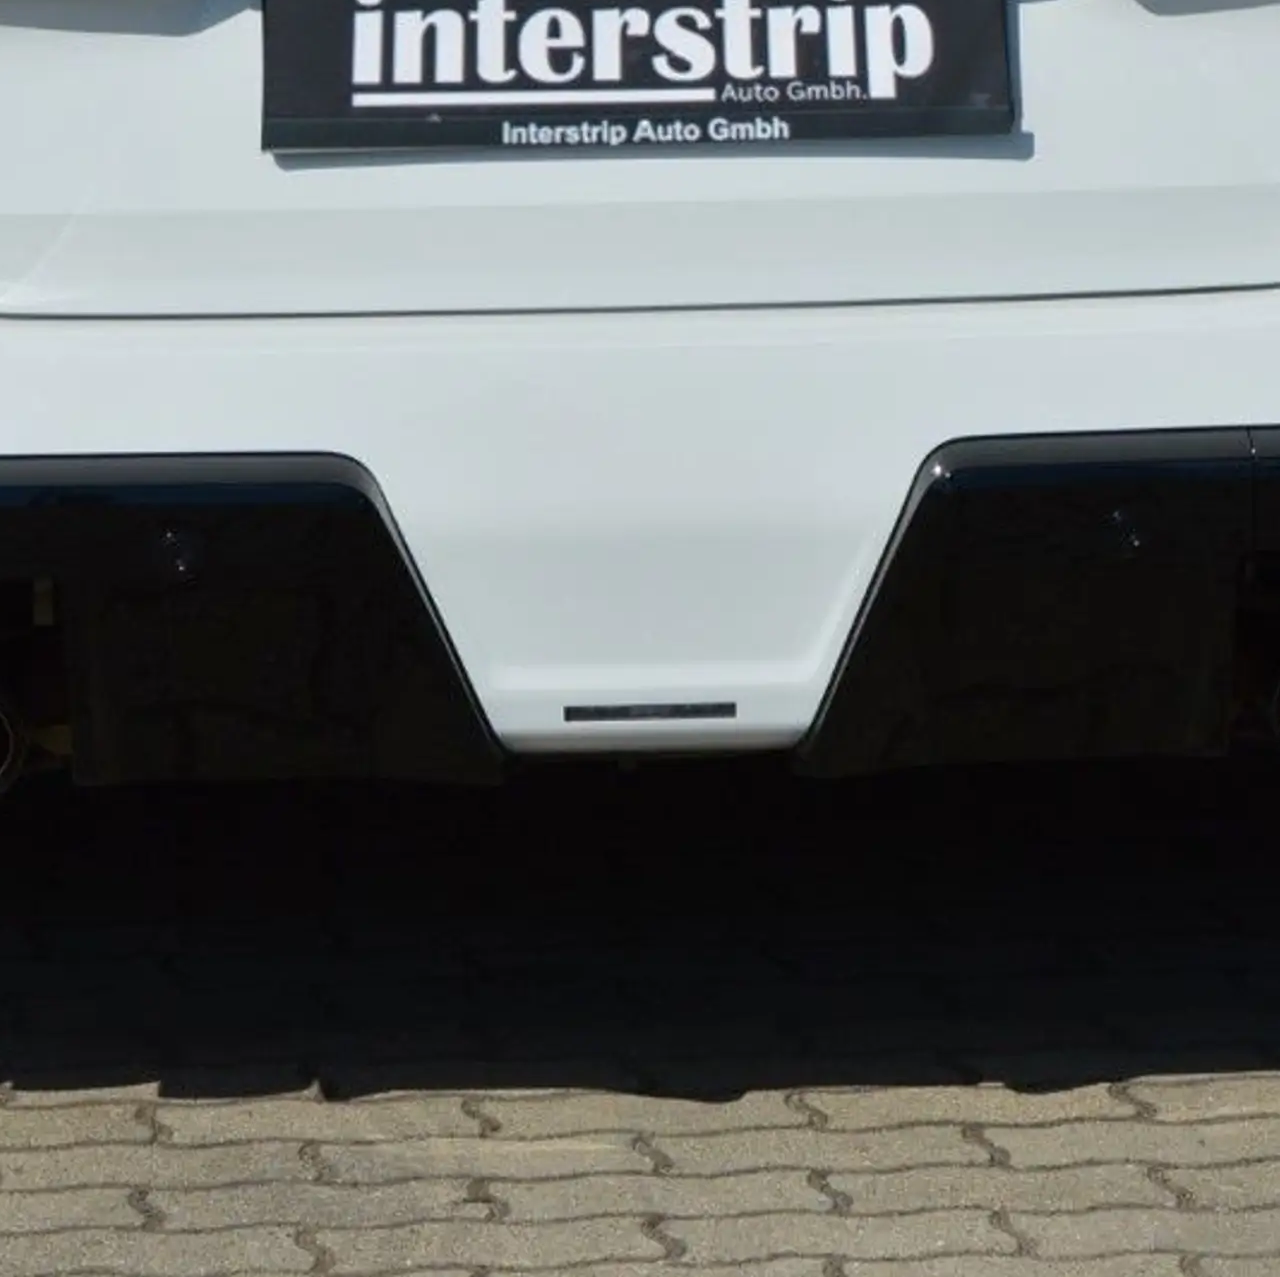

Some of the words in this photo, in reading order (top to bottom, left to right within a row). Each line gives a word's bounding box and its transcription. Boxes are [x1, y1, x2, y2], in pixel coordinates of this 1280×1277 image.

[721, 83, 780, 102] Auto
[502, 120, 626, 145] Interstrip
[632, 119, 700, 143] Auto
[708, 116, 790, 141] Gmbh
